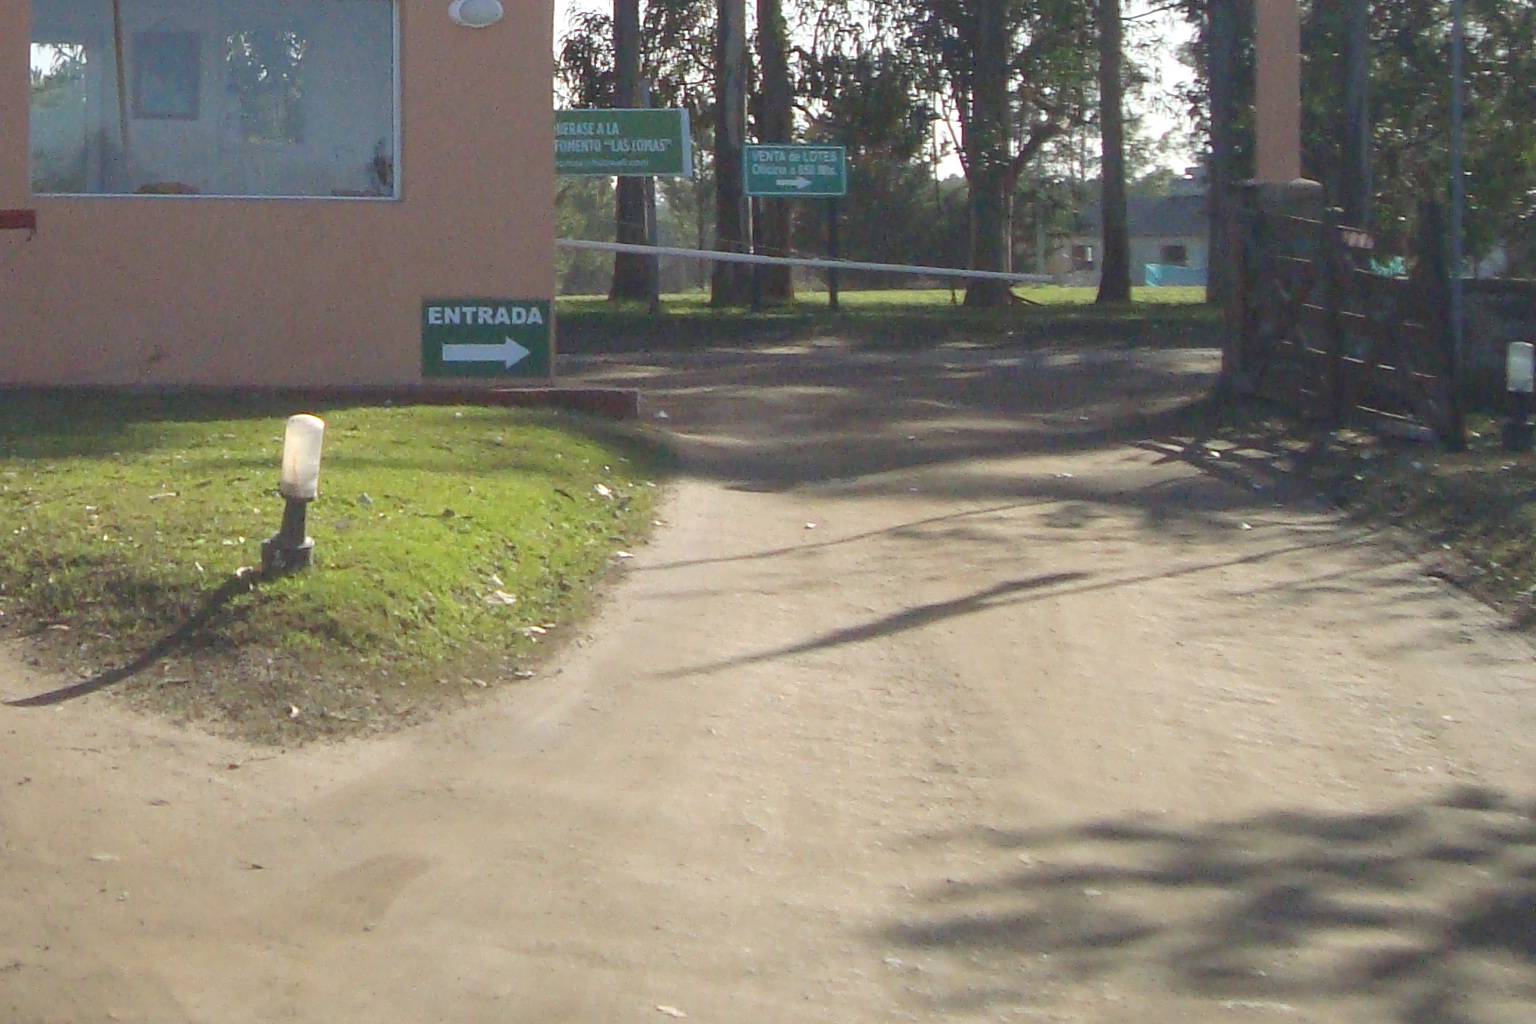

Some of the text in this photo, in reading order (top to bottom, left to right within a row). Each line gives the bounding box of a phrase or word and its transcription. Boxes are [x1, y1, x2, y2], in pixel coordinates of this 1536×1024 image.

[607, 122, 620, 136] LA
[752, 150, 786, 163] VENTA
[803, 150, 838, 164] LOTES
[427, 306, 544, 326] ENTRADA
